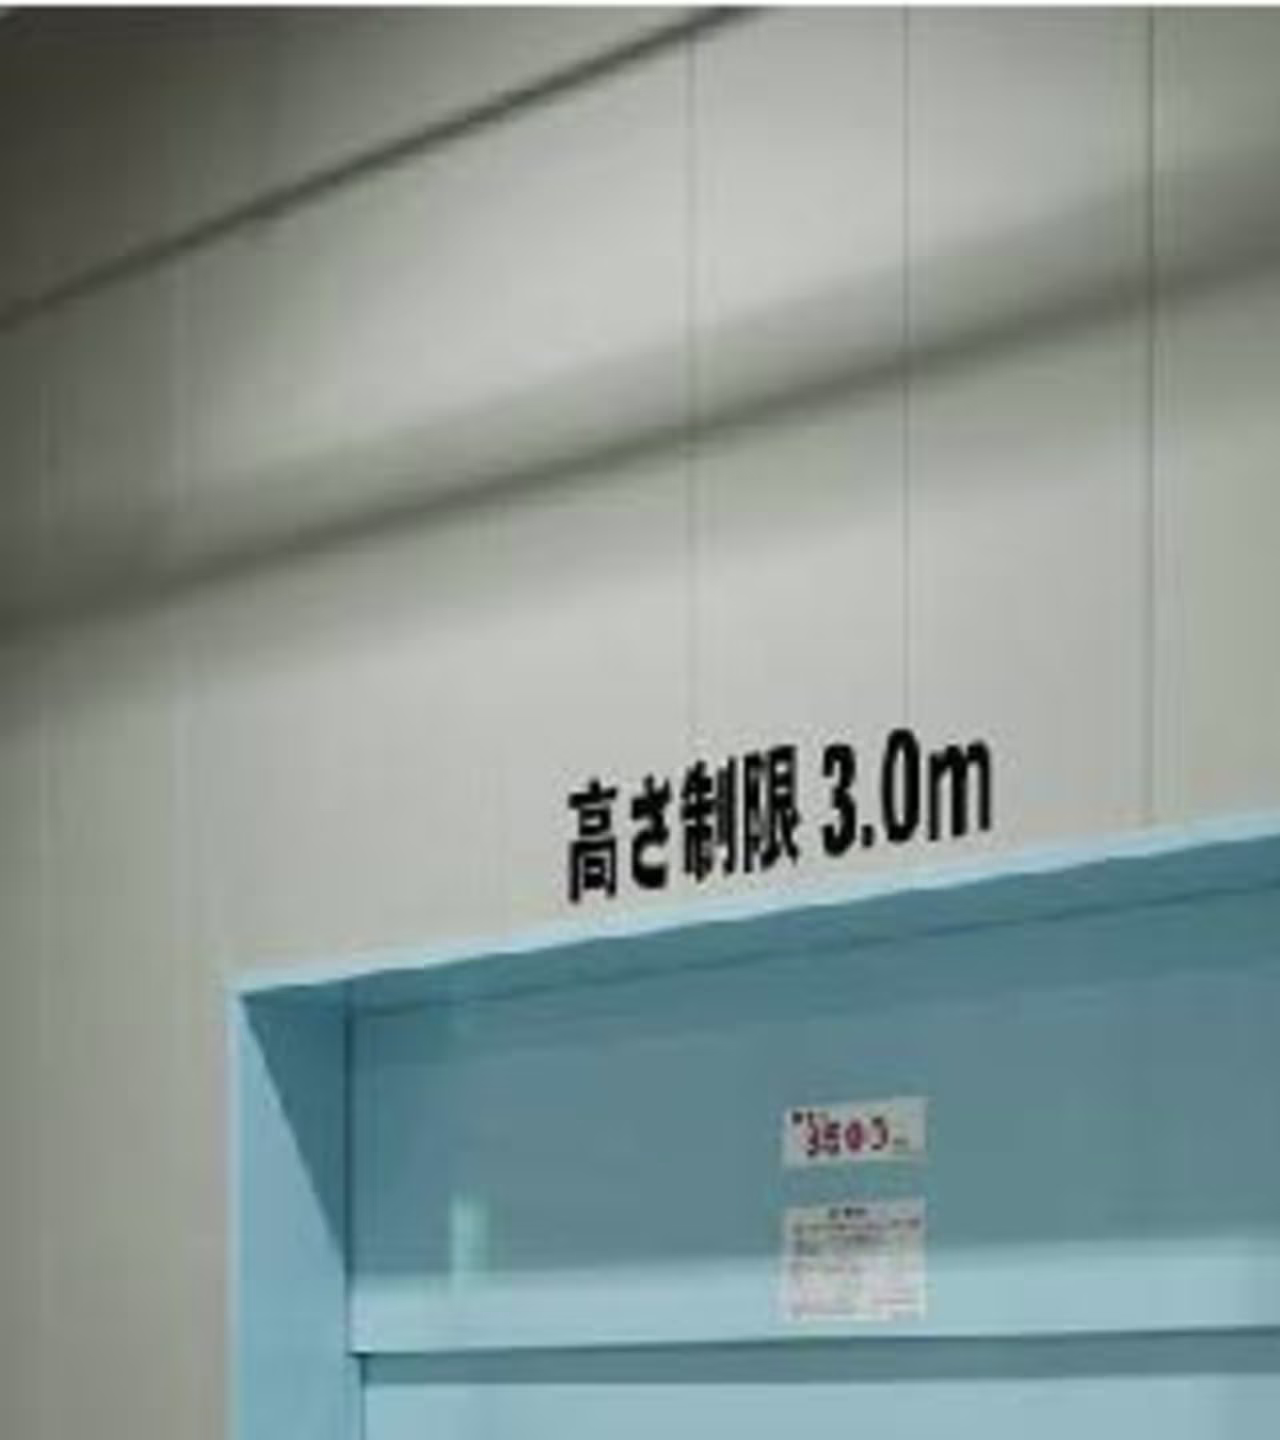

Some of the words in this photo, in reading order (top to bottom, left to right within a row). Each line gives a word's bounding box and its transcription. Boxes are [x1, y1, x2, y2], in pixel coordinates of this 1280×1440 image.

[567, 745, 801, 904] 高さ制限
[821, 728, 992, 857] 3.0m
